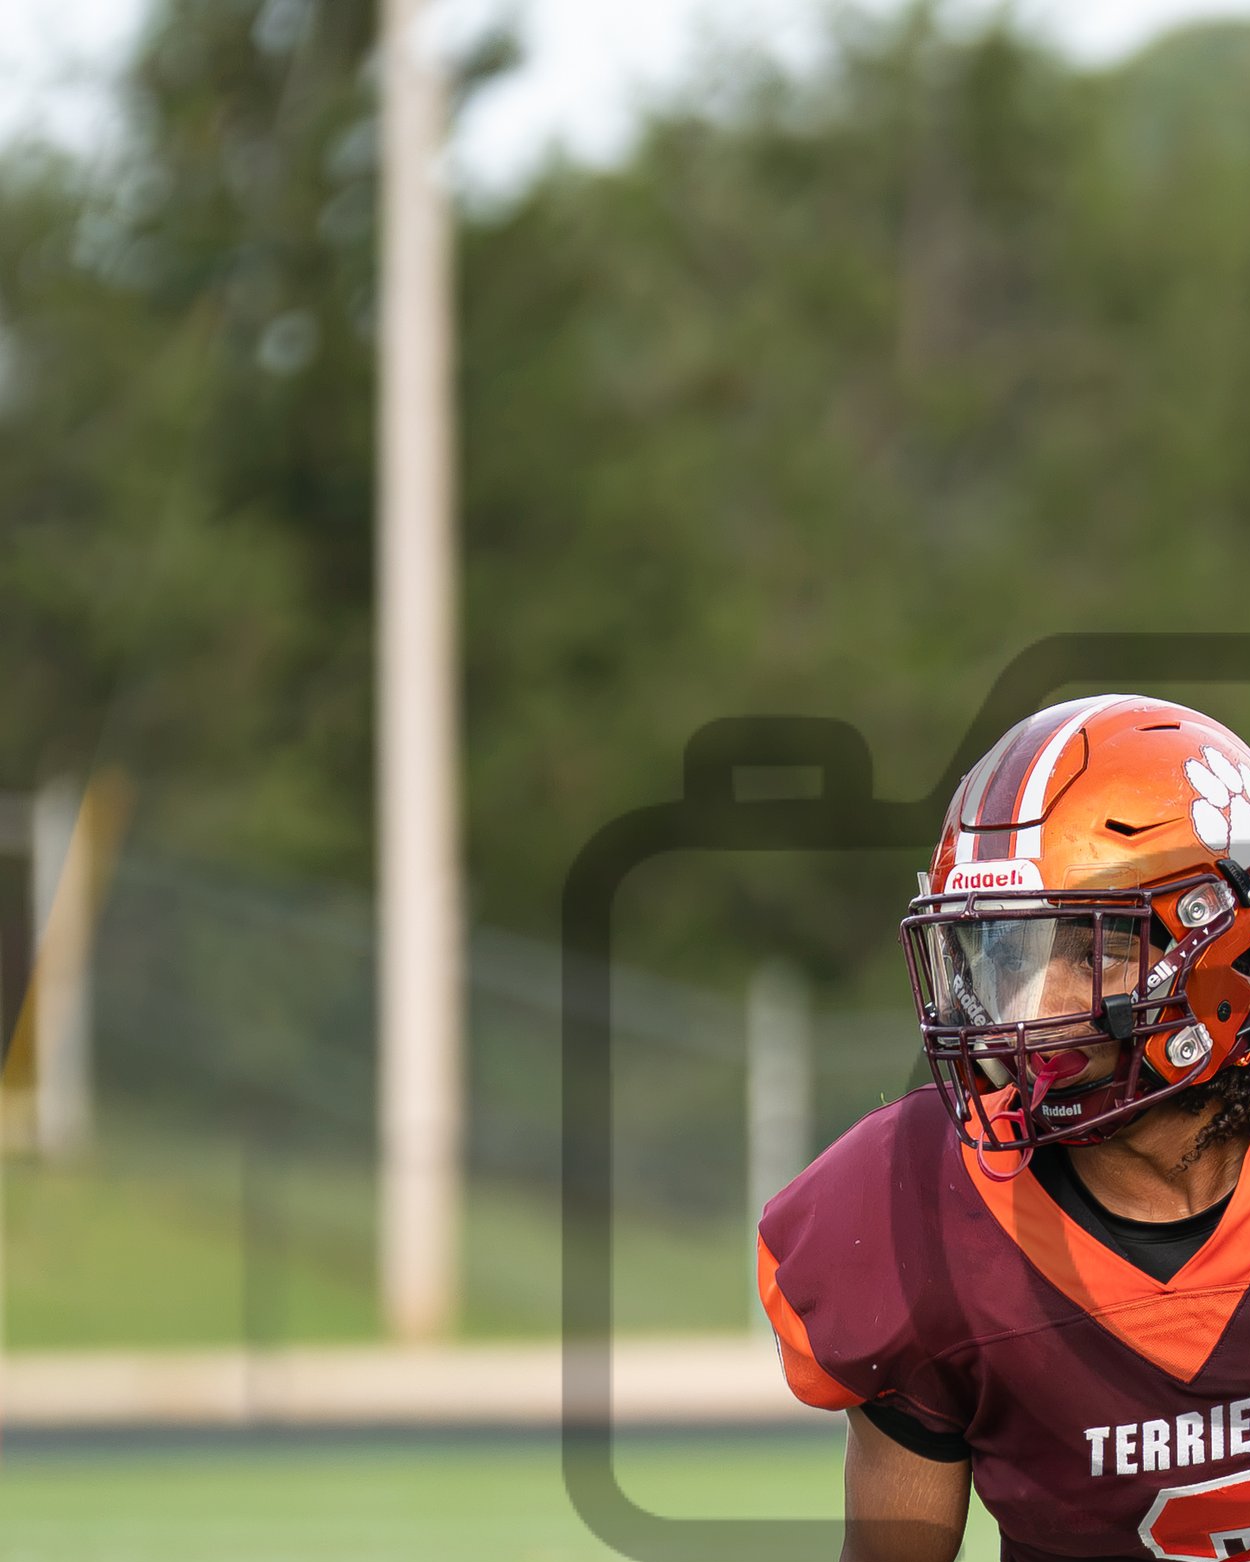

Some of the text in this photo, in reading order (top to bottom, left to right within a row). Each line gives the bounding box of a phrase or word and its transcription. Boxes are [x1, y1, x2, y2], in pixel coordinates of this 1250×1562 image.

[952, 870, 1023, 889] Riddell
[953, 974, 994, 1027] Ridde
[1041, 1103, 1082, 1117] Riddell
